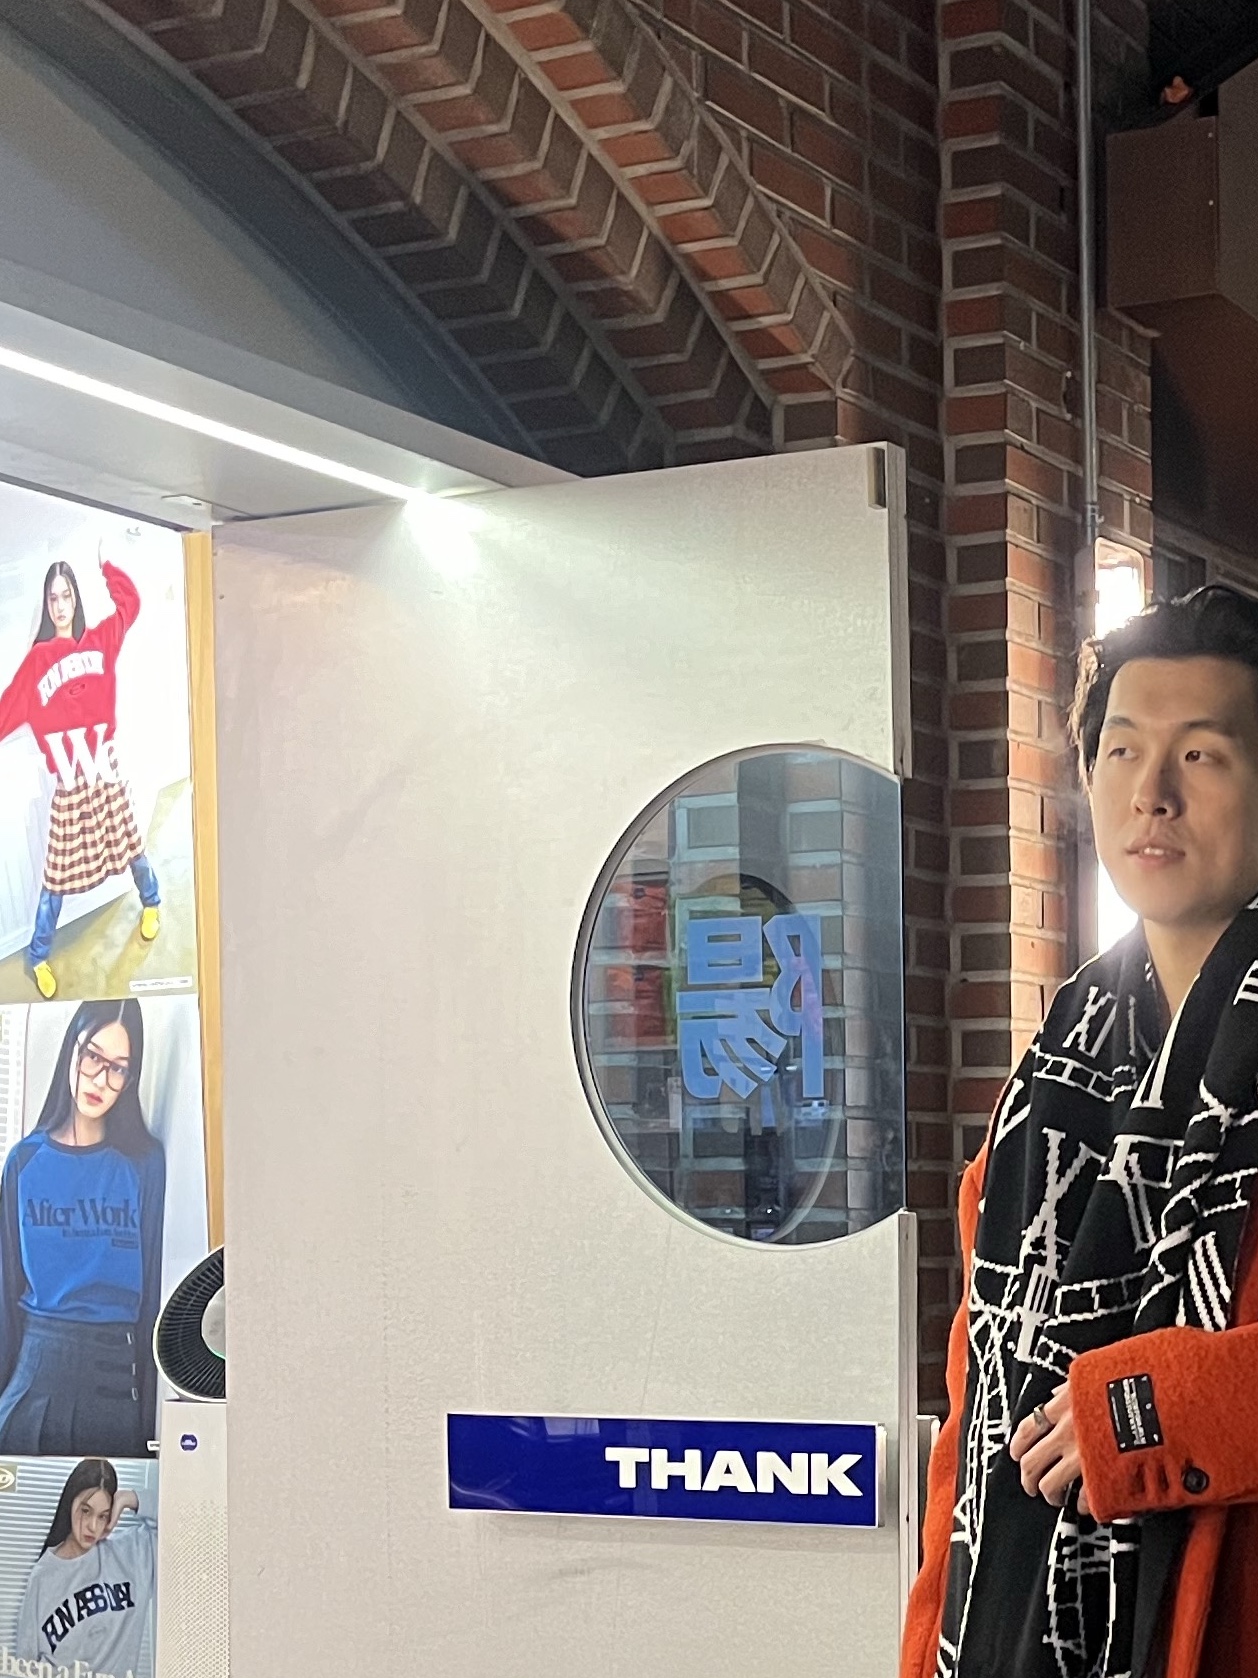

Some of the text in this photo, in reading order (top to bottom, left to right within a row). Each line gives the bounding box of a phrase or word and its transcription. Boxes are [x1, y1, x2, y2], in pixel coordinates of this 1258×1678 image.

[22, 1198, 138, 1228] After Work
[604, 1446, 864, 1497] THANK
